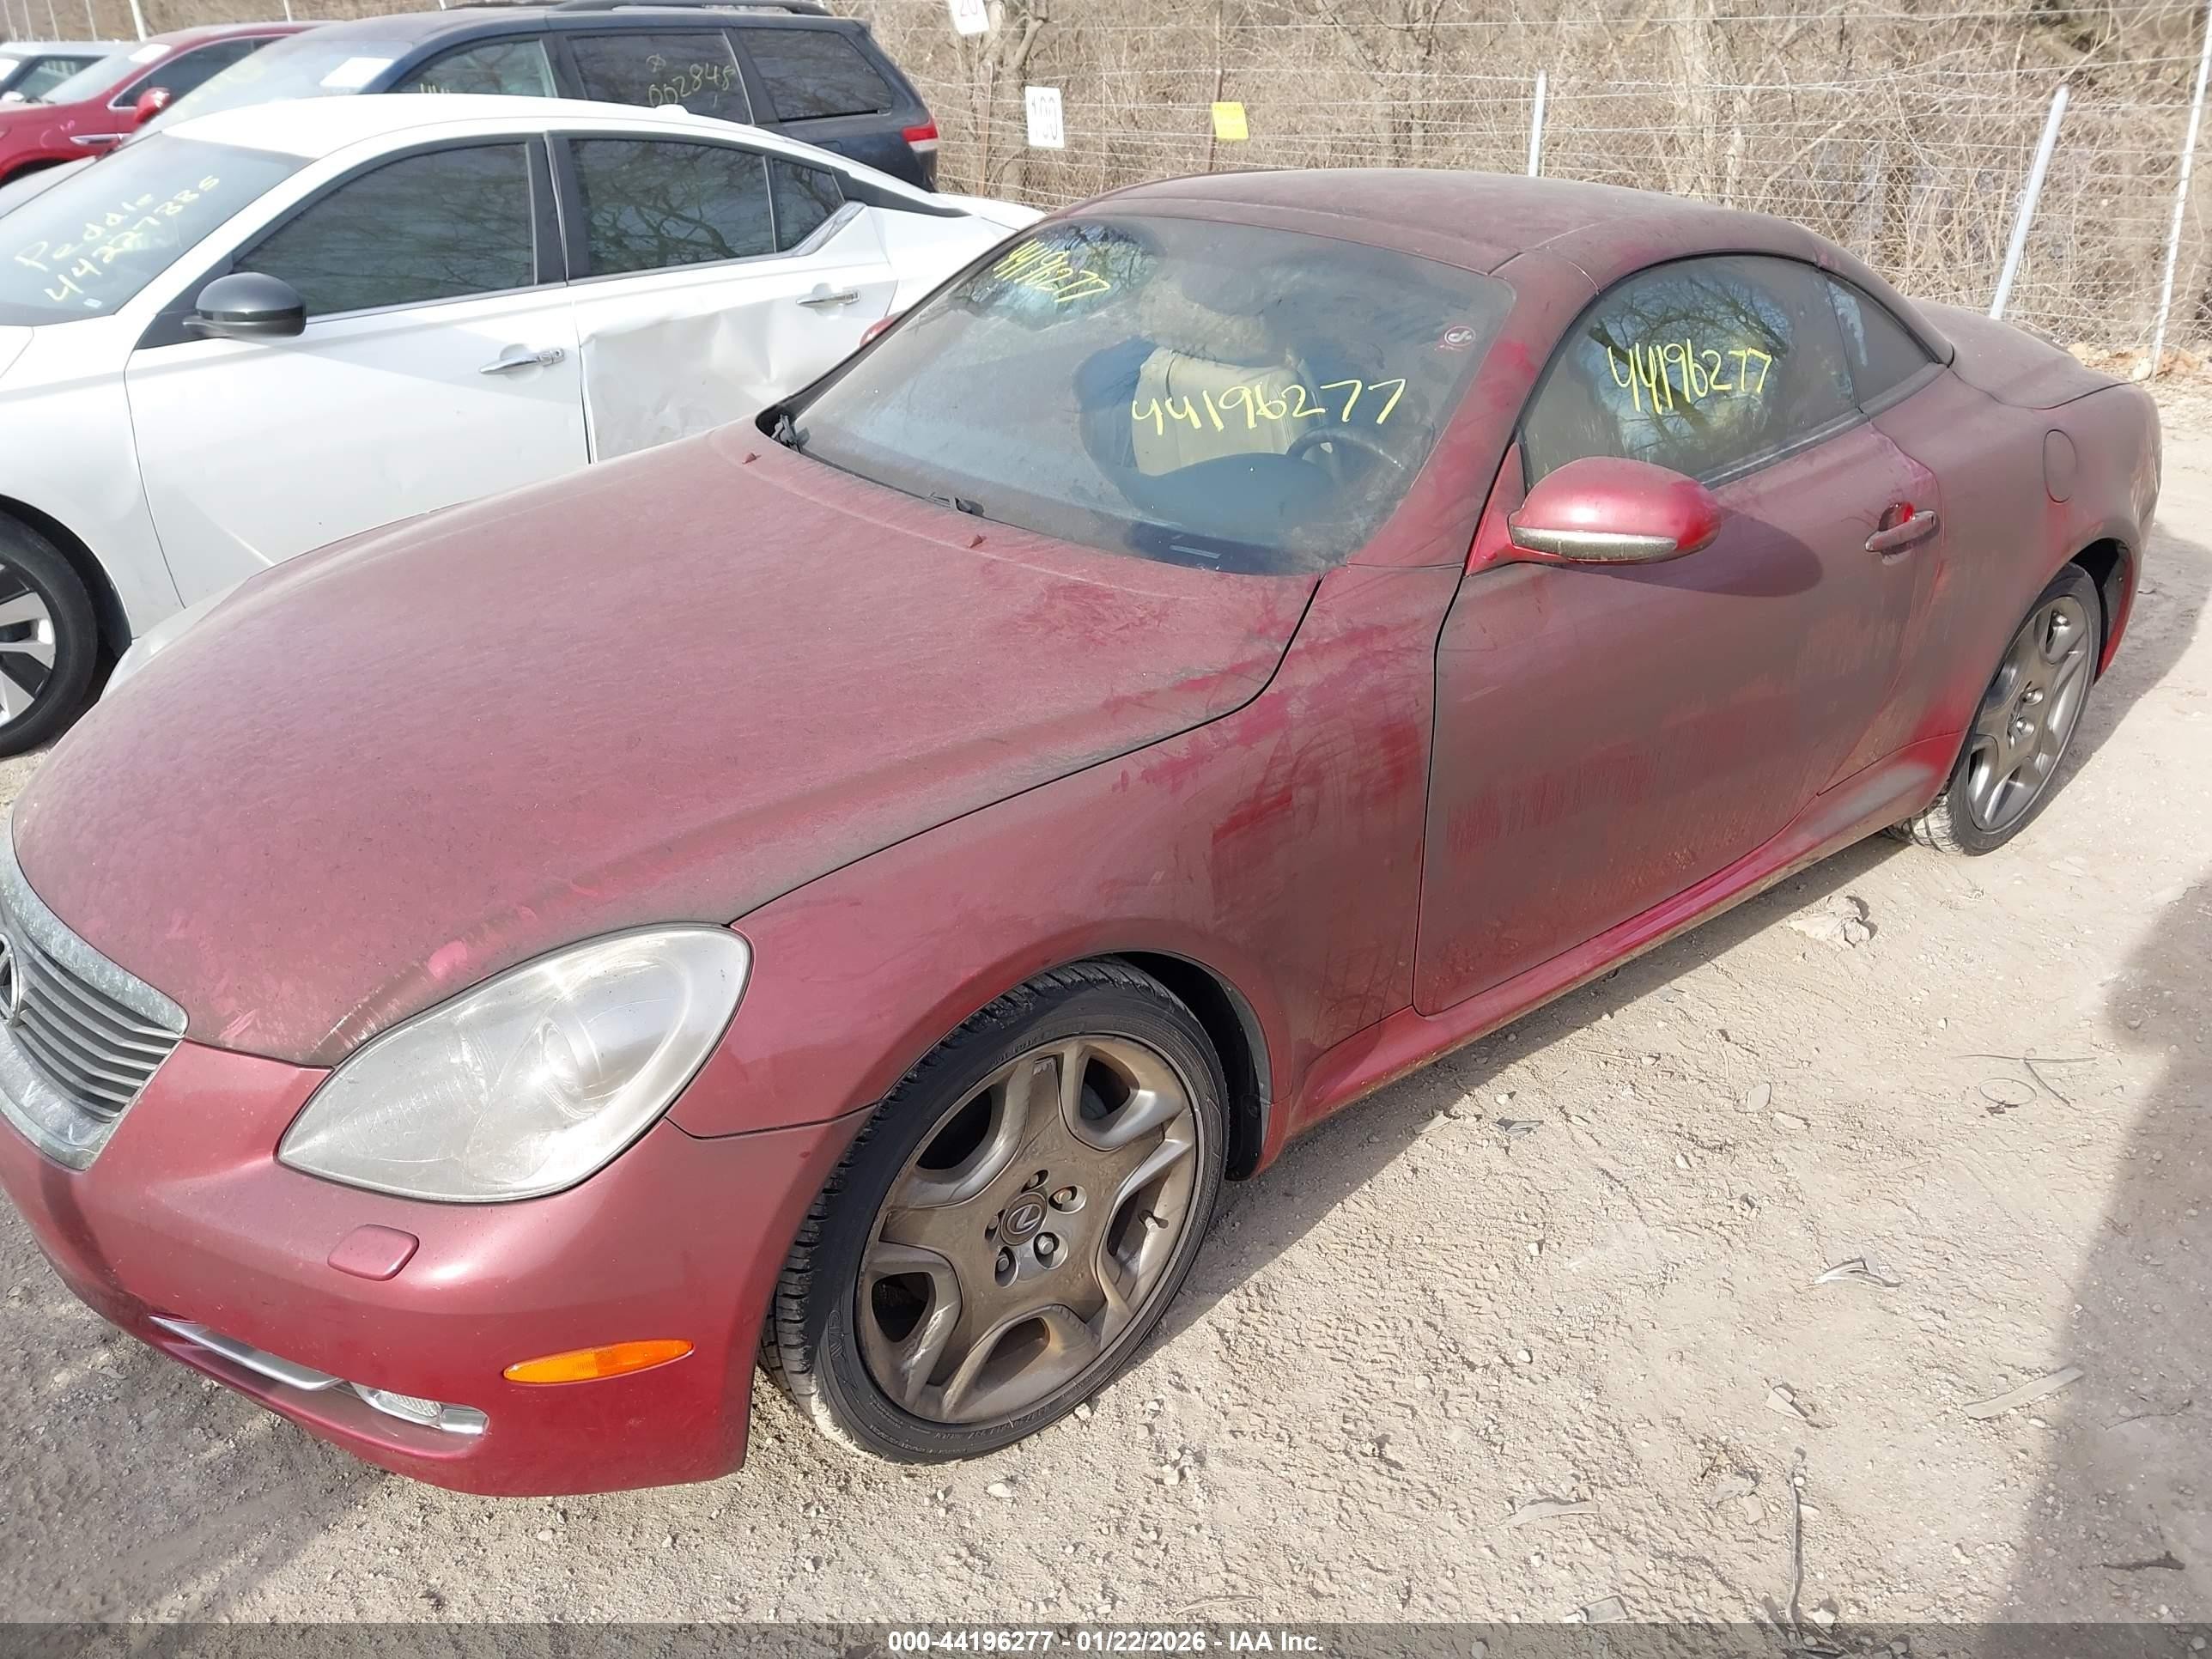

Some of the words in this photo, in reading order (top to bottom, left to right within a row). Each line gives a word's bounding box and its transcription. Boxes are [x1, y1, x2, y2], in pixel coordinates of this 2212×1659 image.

[993, 237, 1111, 303] 44196277
[1131, 378, 1407, 435] 44196277
[1607, 337, 1772, 415] 44196277
